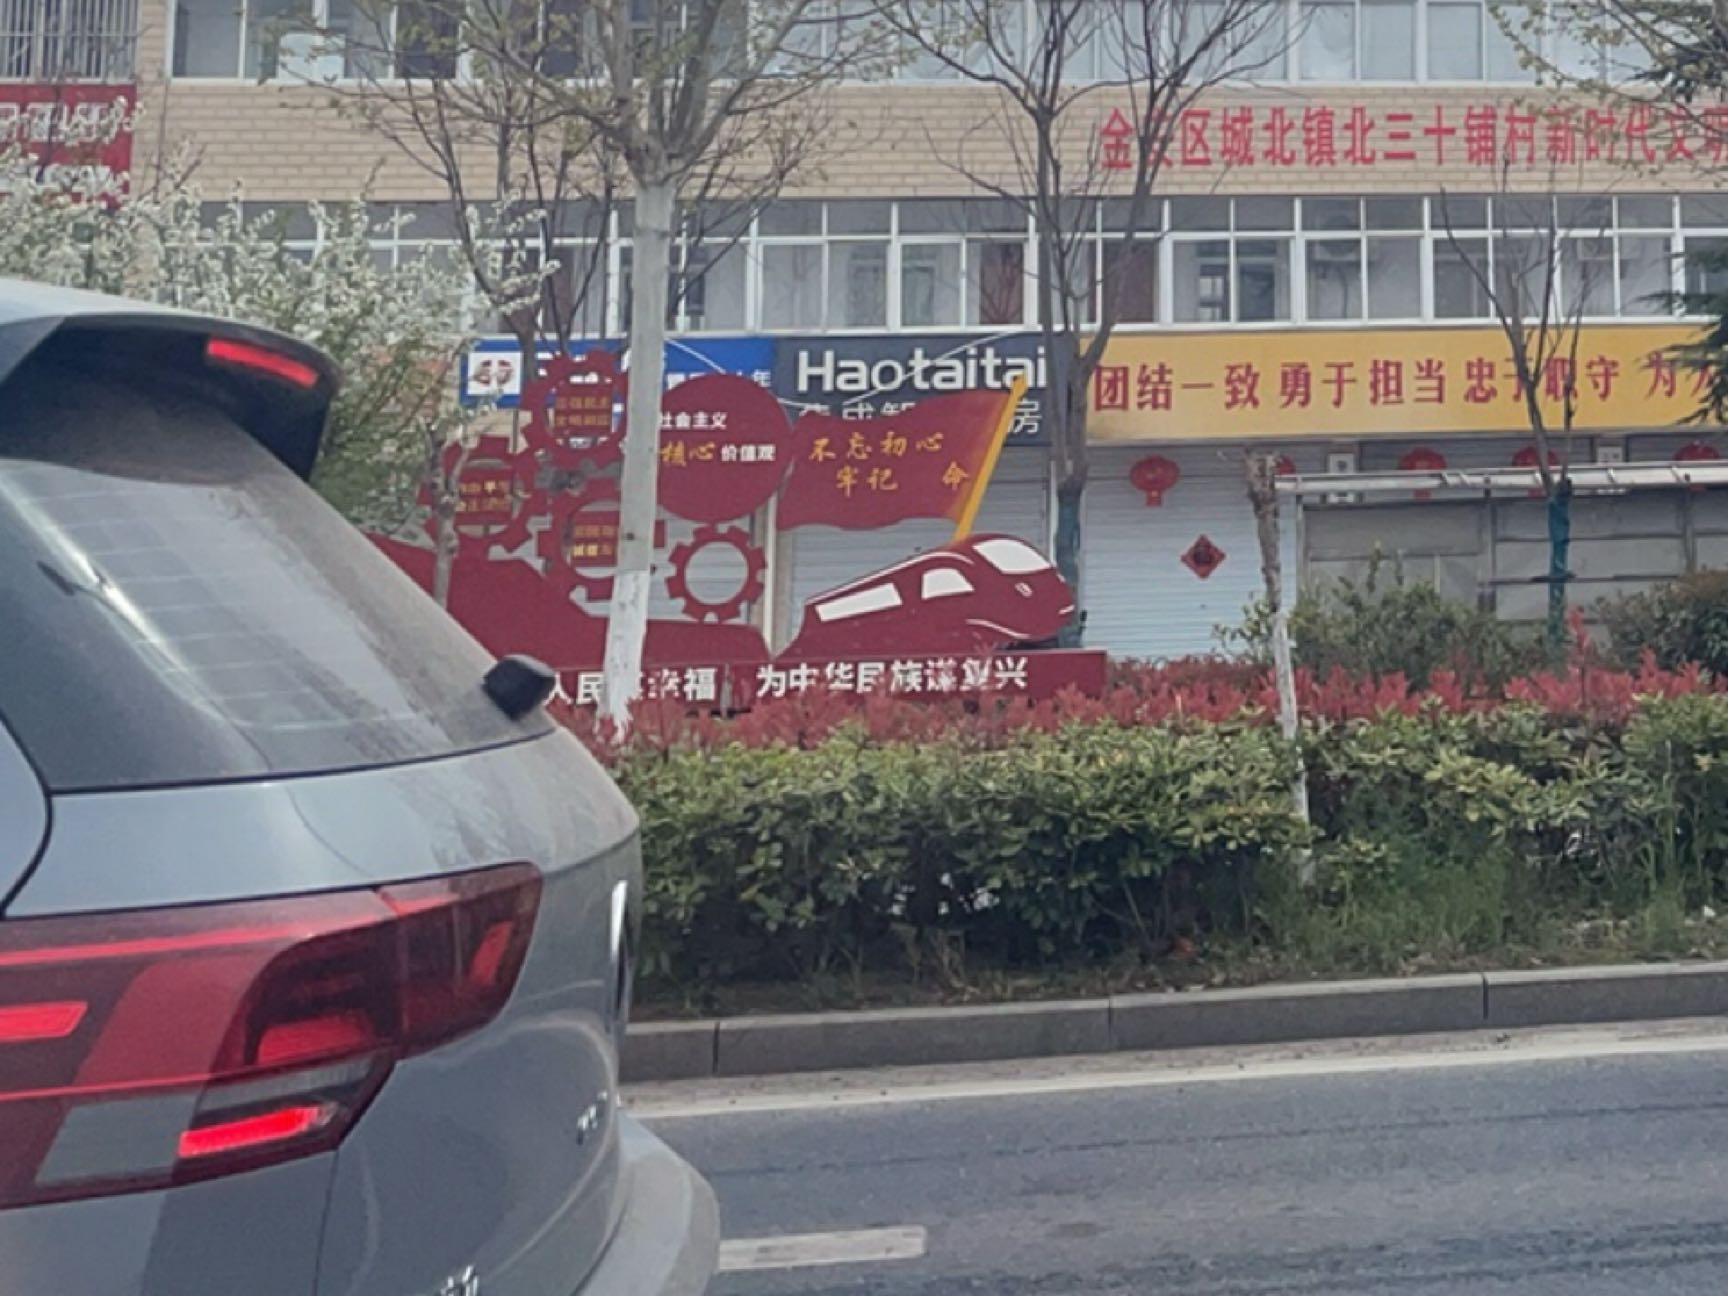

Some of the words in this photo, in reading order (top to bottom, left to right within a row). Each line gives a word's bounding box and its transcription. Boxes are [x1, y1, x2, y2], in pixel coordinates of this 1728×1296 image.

[797, 346, 1047, 392] Haotaitai
[1094, 361, 1260, 411] 团结一致
[1280, 358, 1446, 408] 勇于担当
[808, 431, 944, 462] 不忘初心
